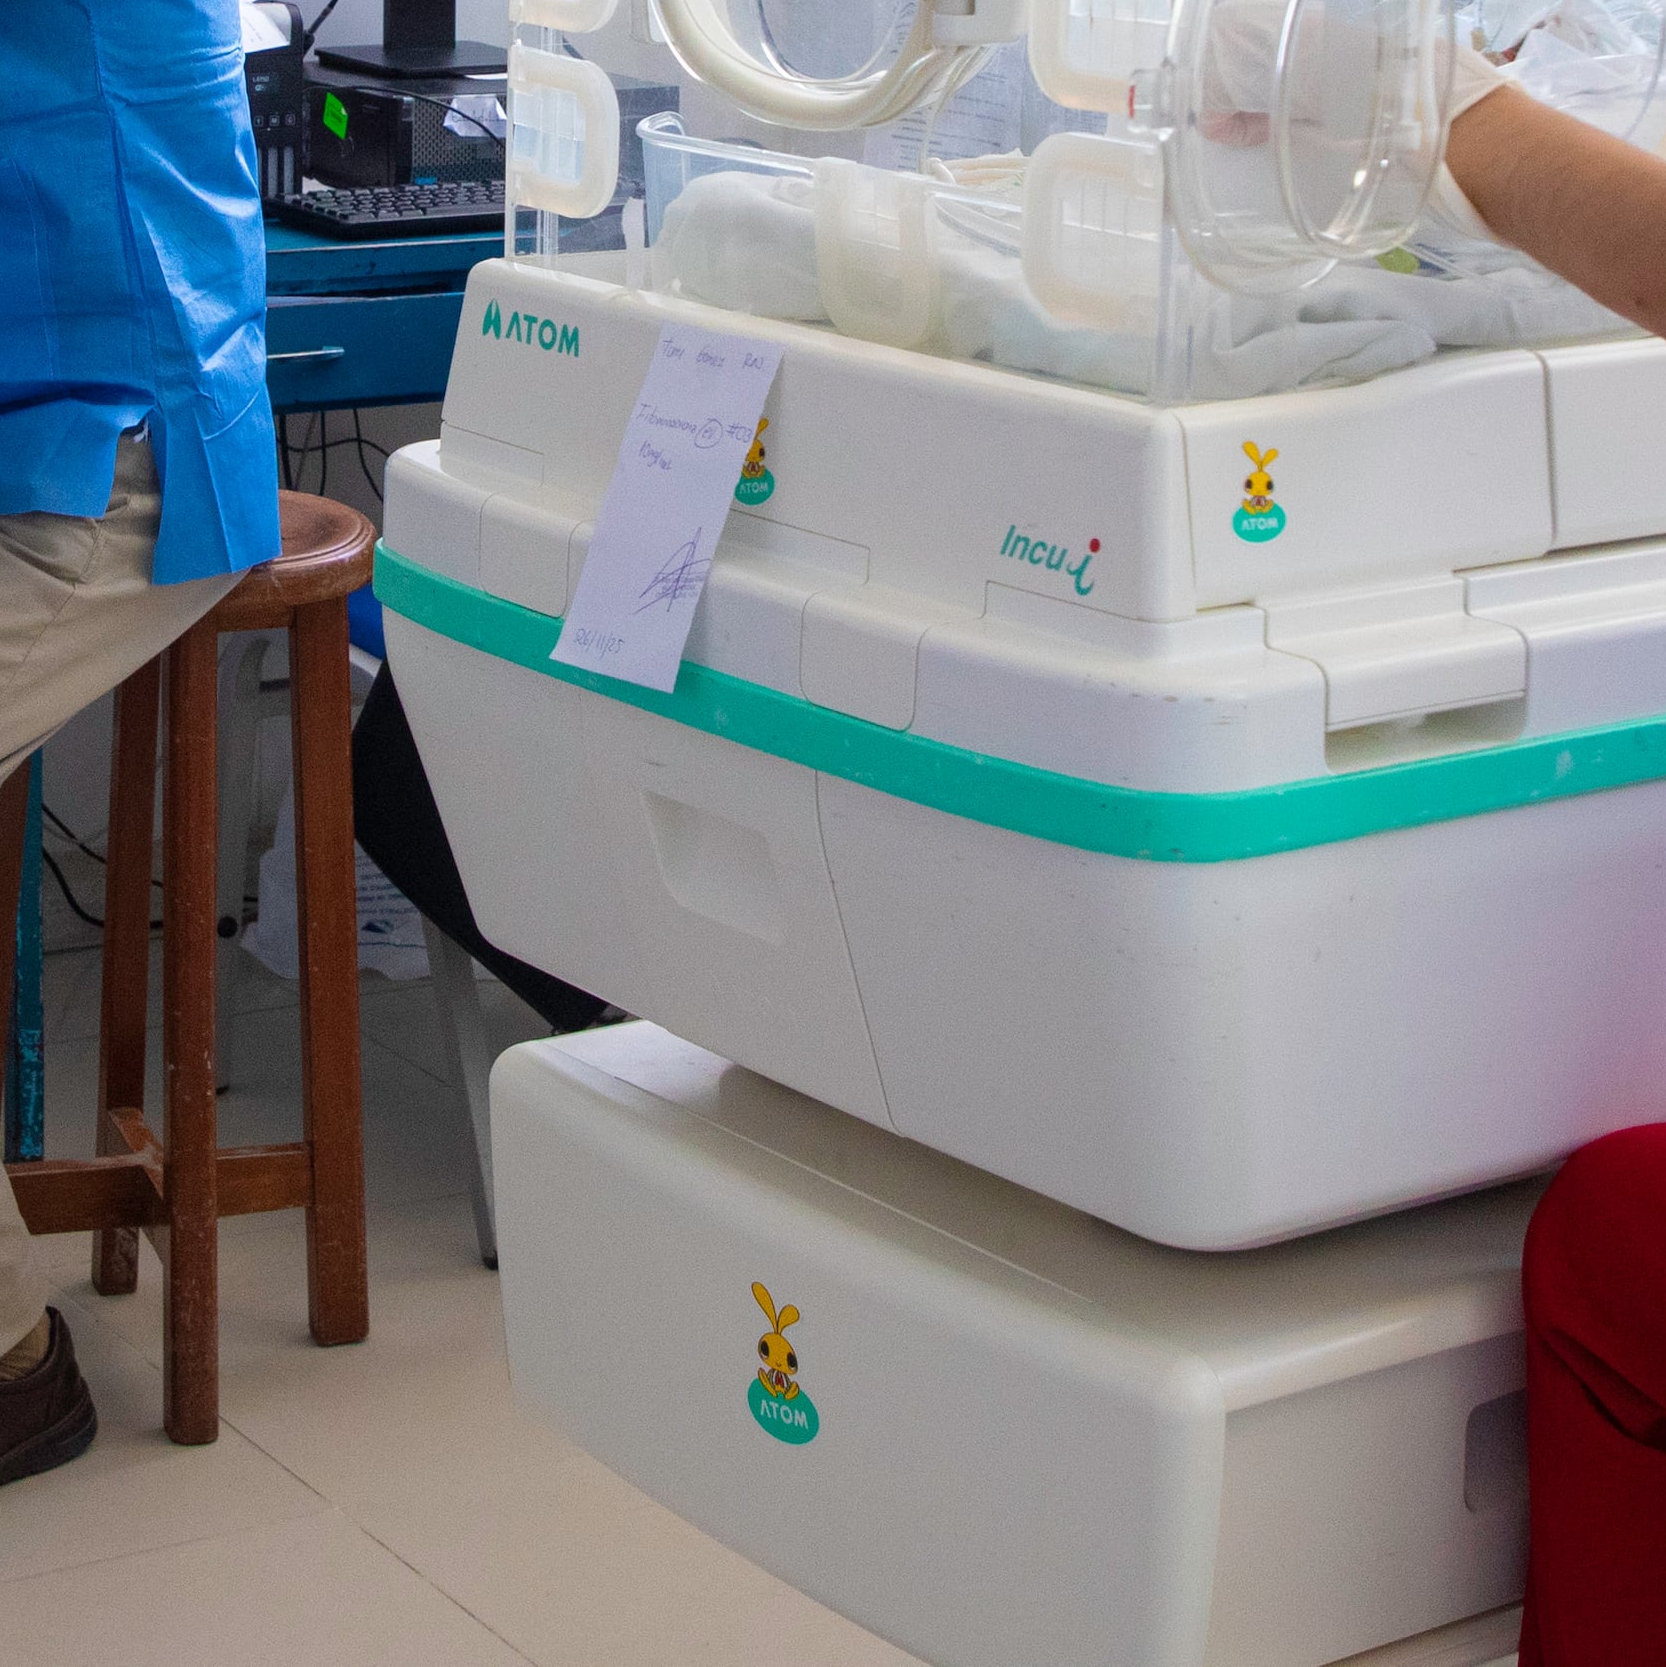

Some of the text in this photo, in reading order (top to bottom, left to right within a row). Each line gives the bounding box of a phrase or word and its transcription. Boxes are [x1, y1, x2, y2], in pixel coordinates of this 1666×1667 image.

[505, 311, 580, 358] ATOM
[738, 482, 769, 494] ATOM
[1242, 517, 1278, 531] ATOM
[760, 1399, 808, 1429] ATOM
